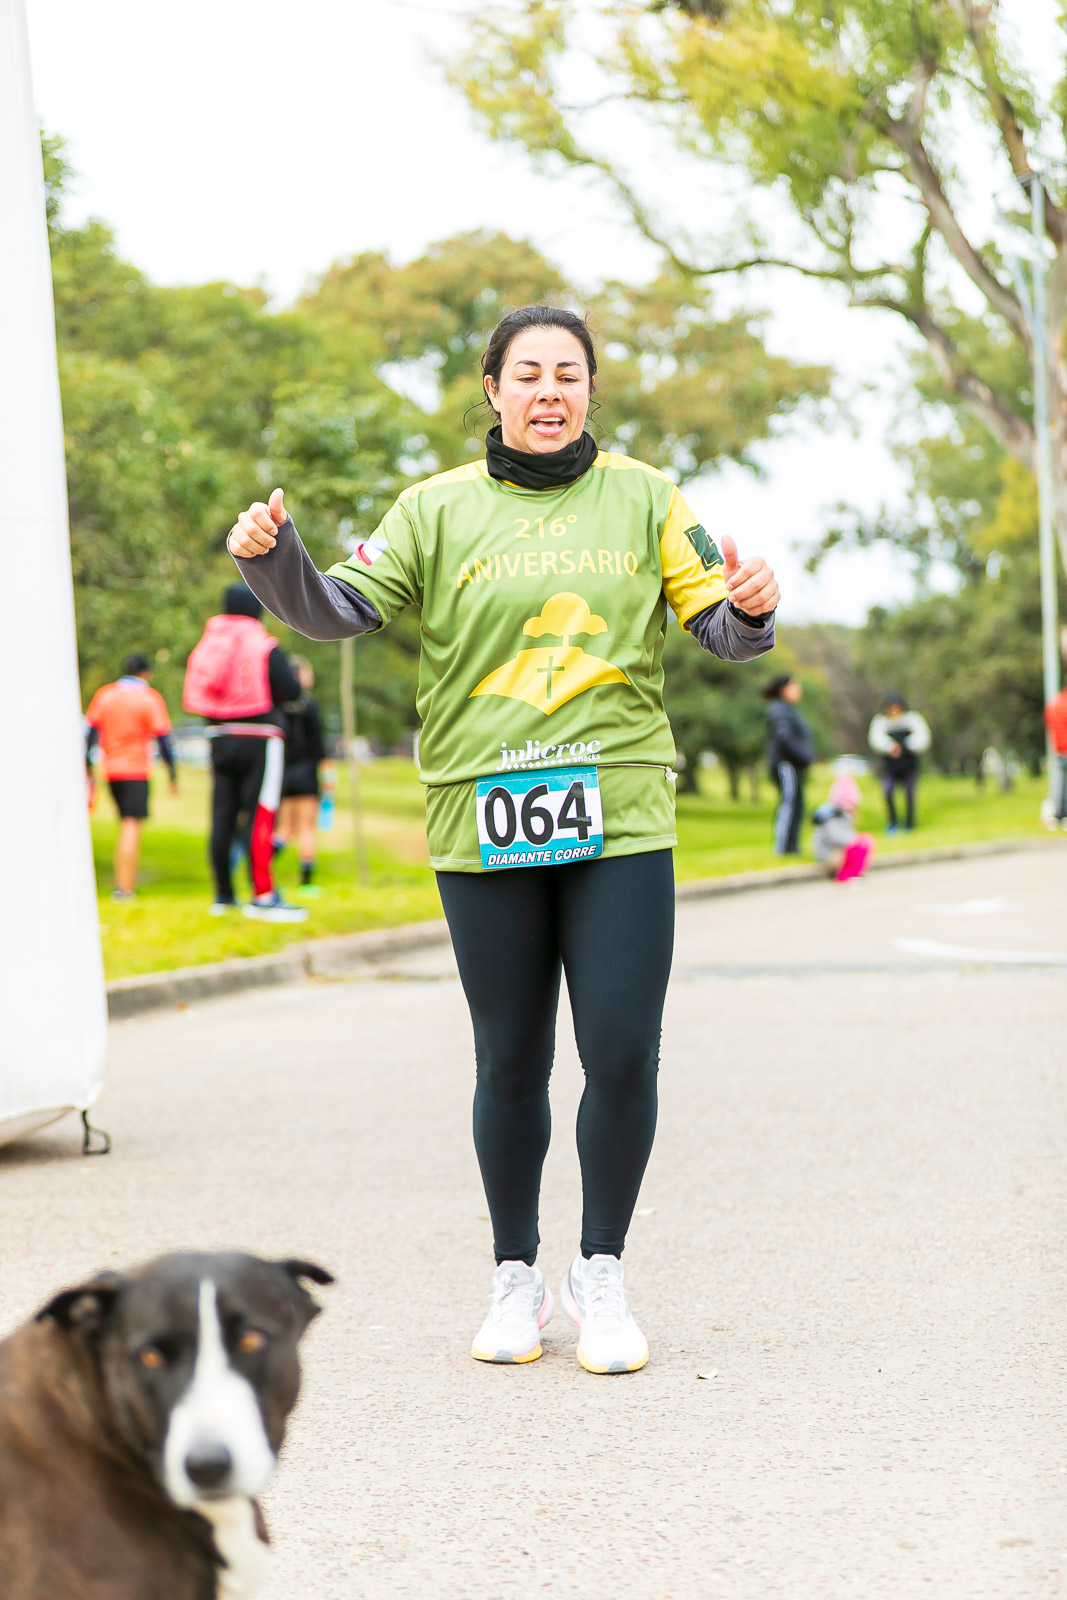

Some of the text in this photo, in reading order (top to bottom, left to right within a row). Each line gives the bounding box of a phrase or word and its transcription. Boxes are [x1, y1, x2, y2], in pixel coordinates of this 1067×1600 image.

[514, 514, 577, 539] 216°
[456, 549, 639, 589] ANIVERSARIO
[496, 740, 601, 772] julicroc
[484, 781, 593, 849] 064
[487, 845, 597, 866] DIAMANTE CORRE
